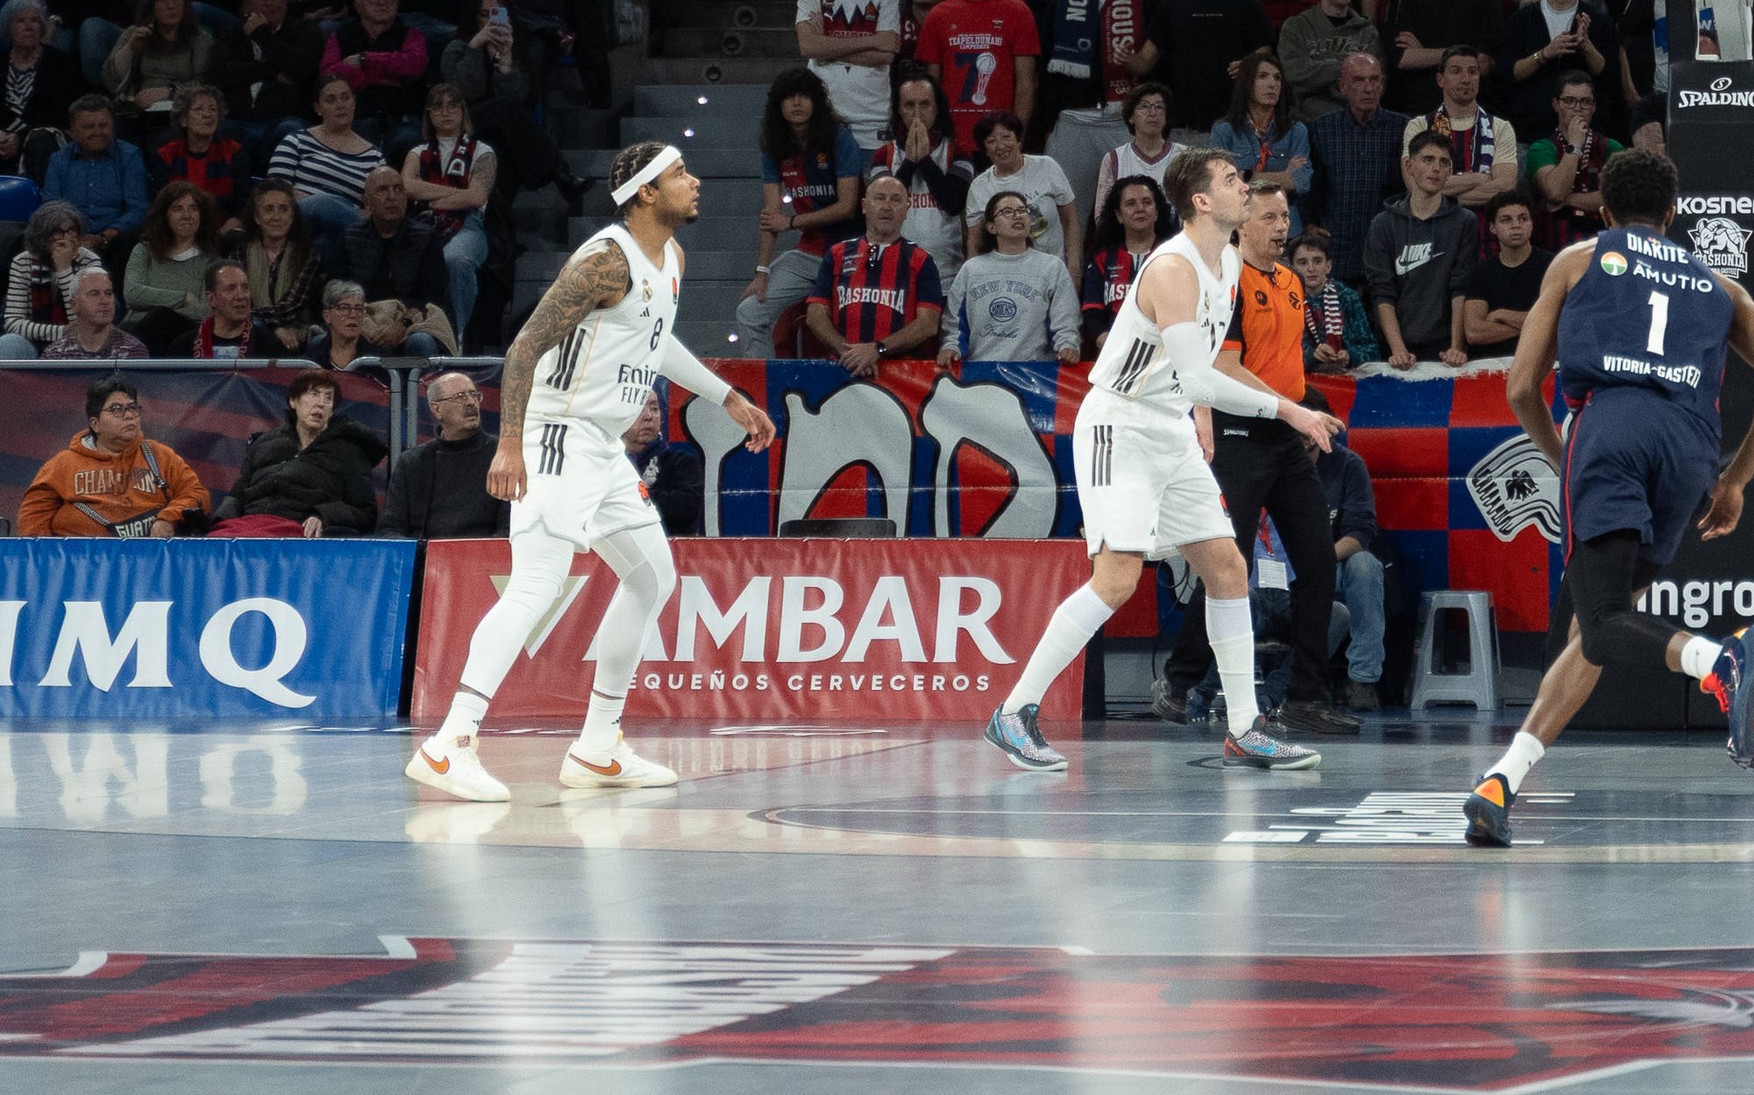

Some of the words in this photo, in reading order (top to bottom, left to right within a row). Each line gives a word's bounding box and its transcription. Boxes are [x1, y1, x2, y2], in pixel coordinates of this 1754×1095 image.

[1398, 242, 1433, 263] NIKE
[1626, 232, 1690, 265] DIAKITE
[1632, 263, 1714, 294] AMUTIO
[650, 317, 664, 353] 8
[1646, 289, 1671, 357] 1
[630, 671, 770, 692] EQUEÑOS
[787, 674, 992, 692] CERVECEROS
